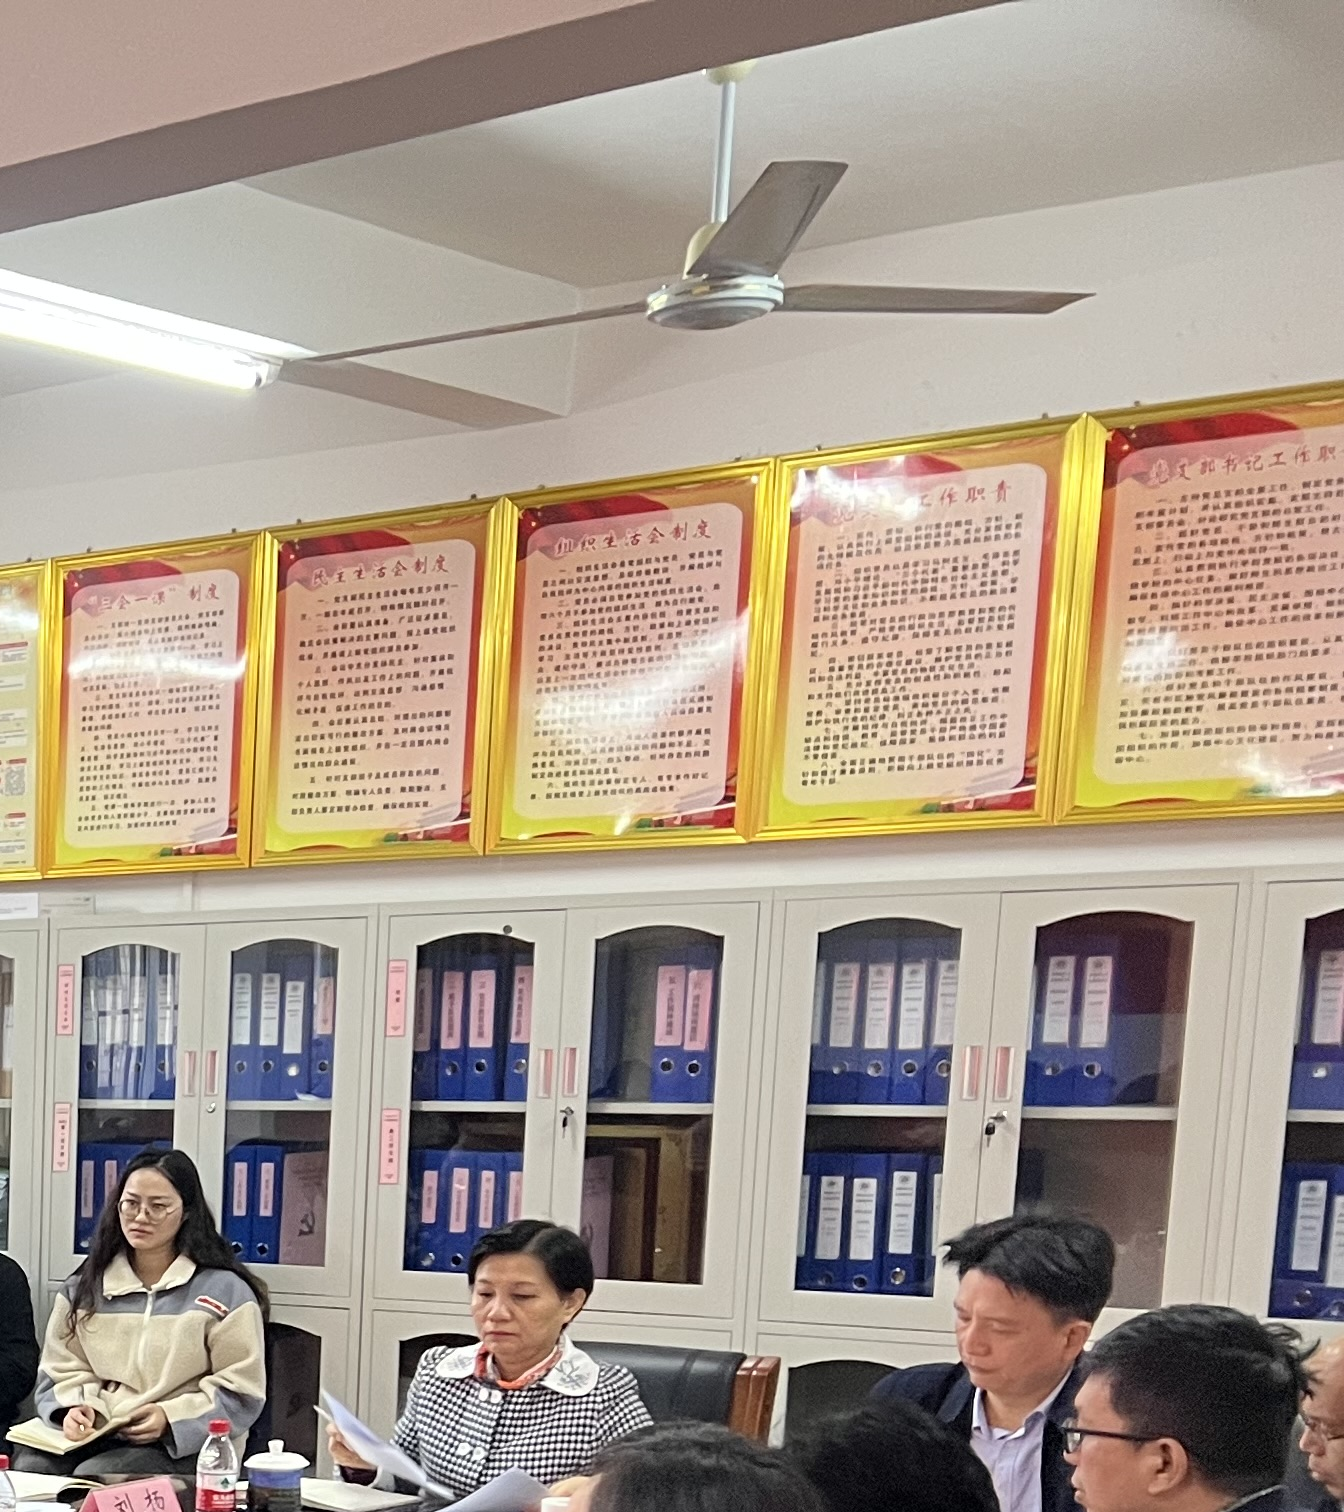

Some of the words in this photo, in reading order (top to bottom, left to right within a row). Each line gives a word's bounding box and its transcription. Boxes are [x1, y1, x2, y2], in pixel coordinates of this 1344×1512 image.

[1146, 444, 1344, 487] 党支部书记工作职
[554, 519, 712, 556] 组织生活会制度
[311, 554, 449, 586] 民主生活会制度
